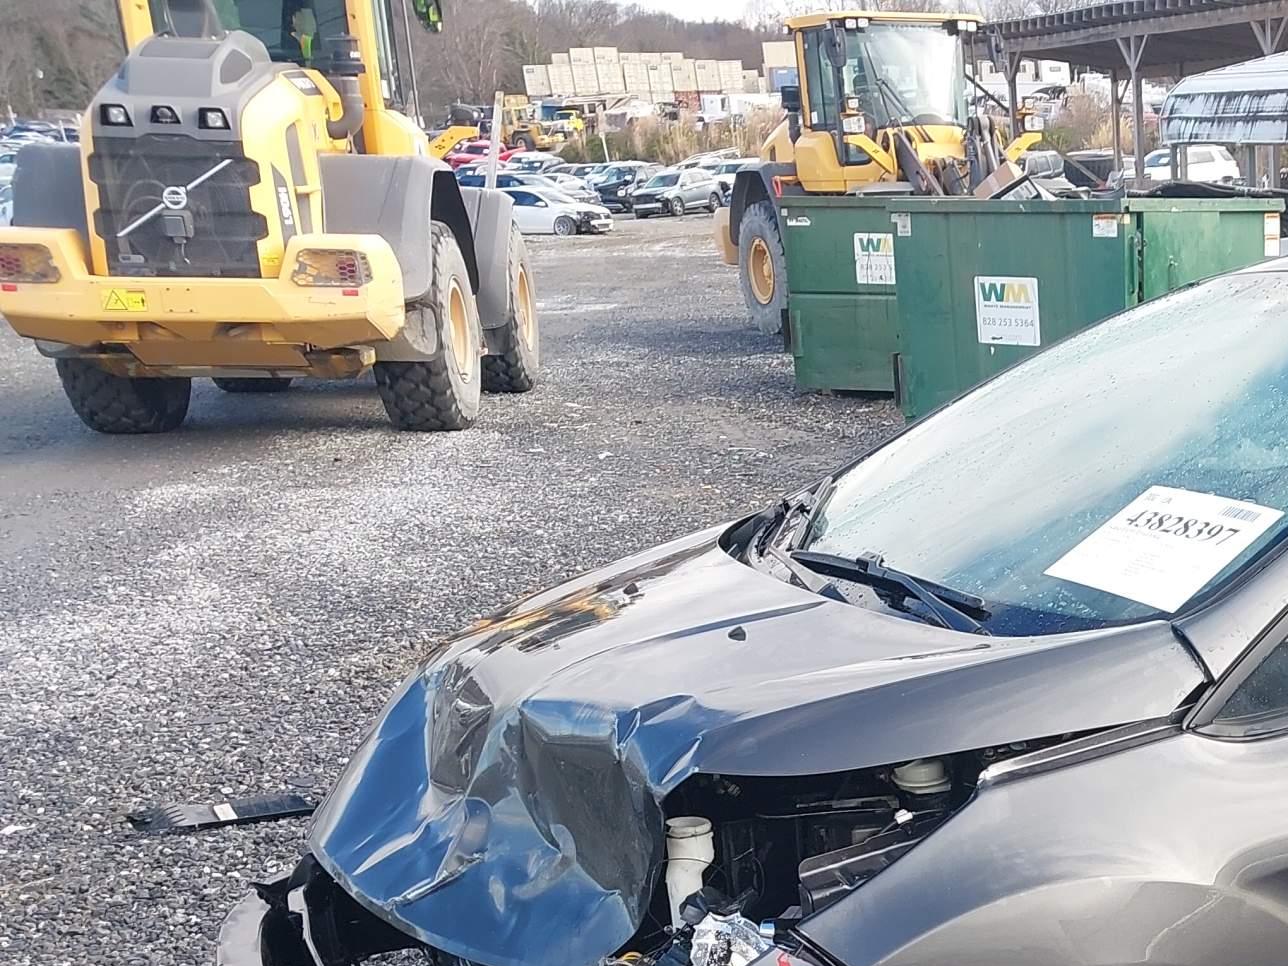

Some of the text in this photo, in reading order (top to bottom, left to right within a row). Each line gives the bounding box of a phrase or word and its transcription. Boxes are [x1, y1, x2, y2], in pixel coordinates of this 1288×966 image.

[980, 282, 1032, 303] WM
[982, 316, 1034, 329] 828 253 5364
[1126, 510, 1241, 545] 43828397
